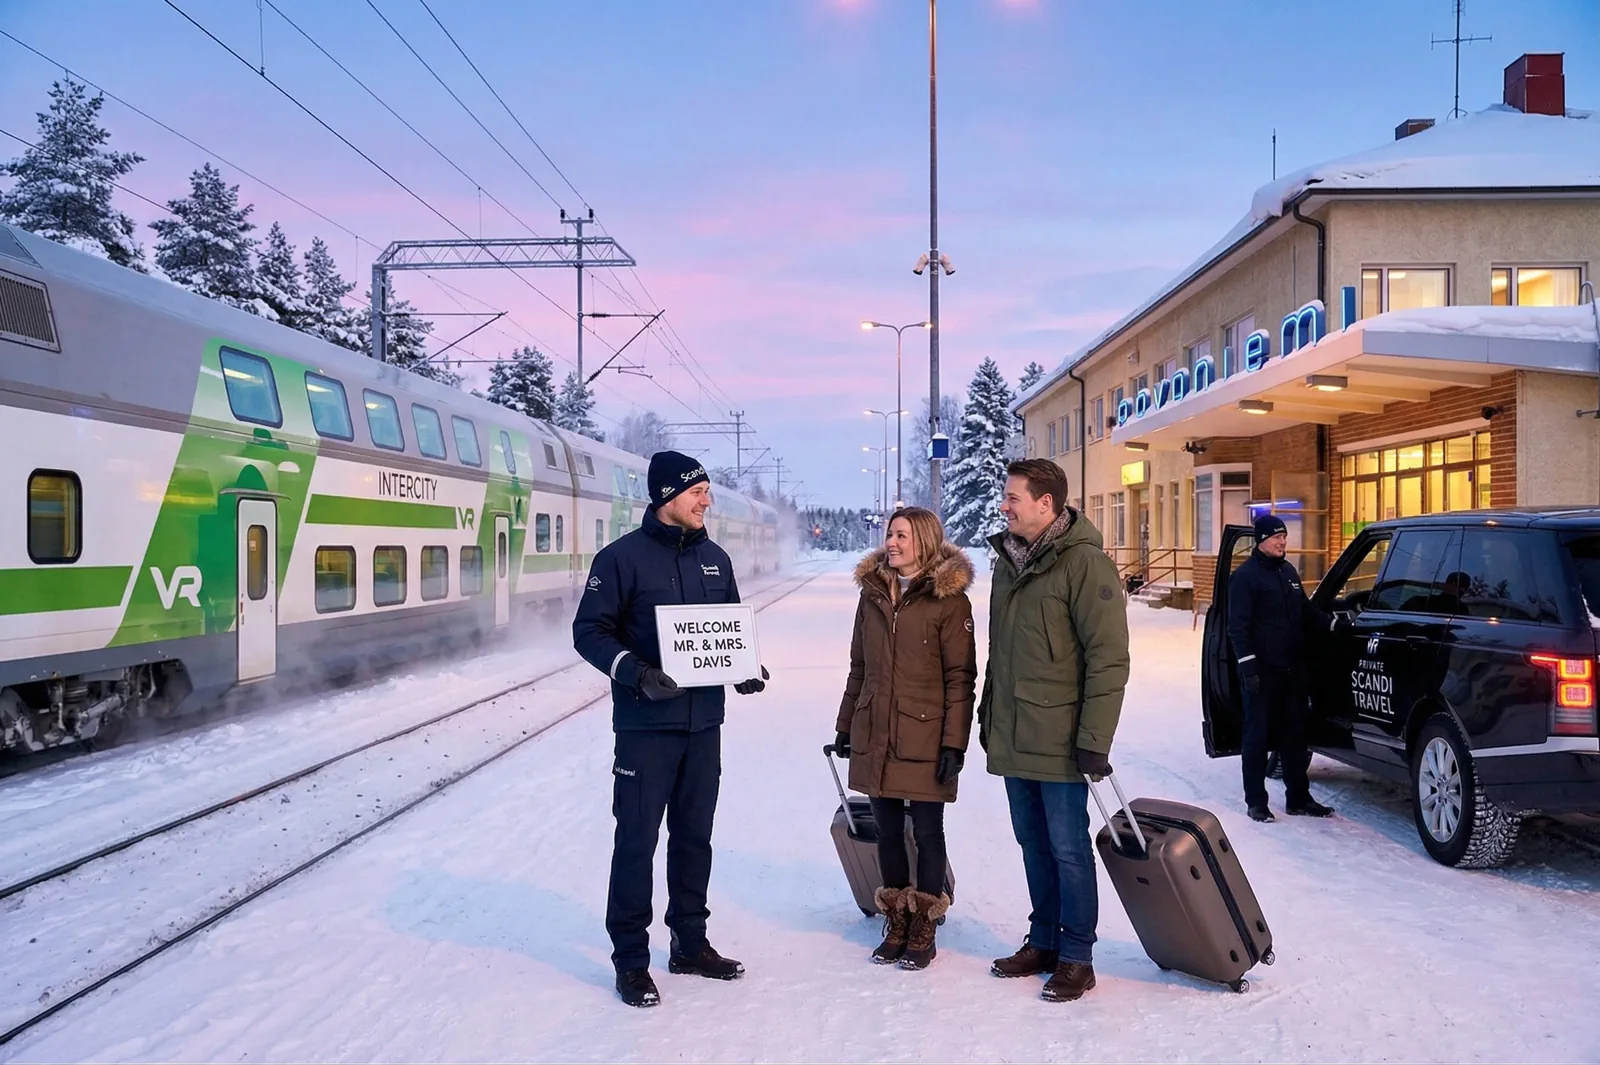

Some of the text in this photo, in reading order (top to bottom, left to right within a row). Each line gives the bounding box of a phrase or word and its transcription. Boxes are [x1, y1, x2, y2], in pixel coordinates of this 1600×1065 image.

[378, 471, 438, 500] INTERCITY
[457, 507, 475, 530] VR
[149, 565, 203, 610] VR
[674, 620, 742, 634] WELCOME
[674, 637, 747, 652] MR. & MRS.
[693, 655, 732, 669] DAVIS
[1359, 659, 1384, 672] PRIVATE
[1351, 670, 1392, 694] SCANDI
[1352, 690, 1395, 715] TRAVEL
